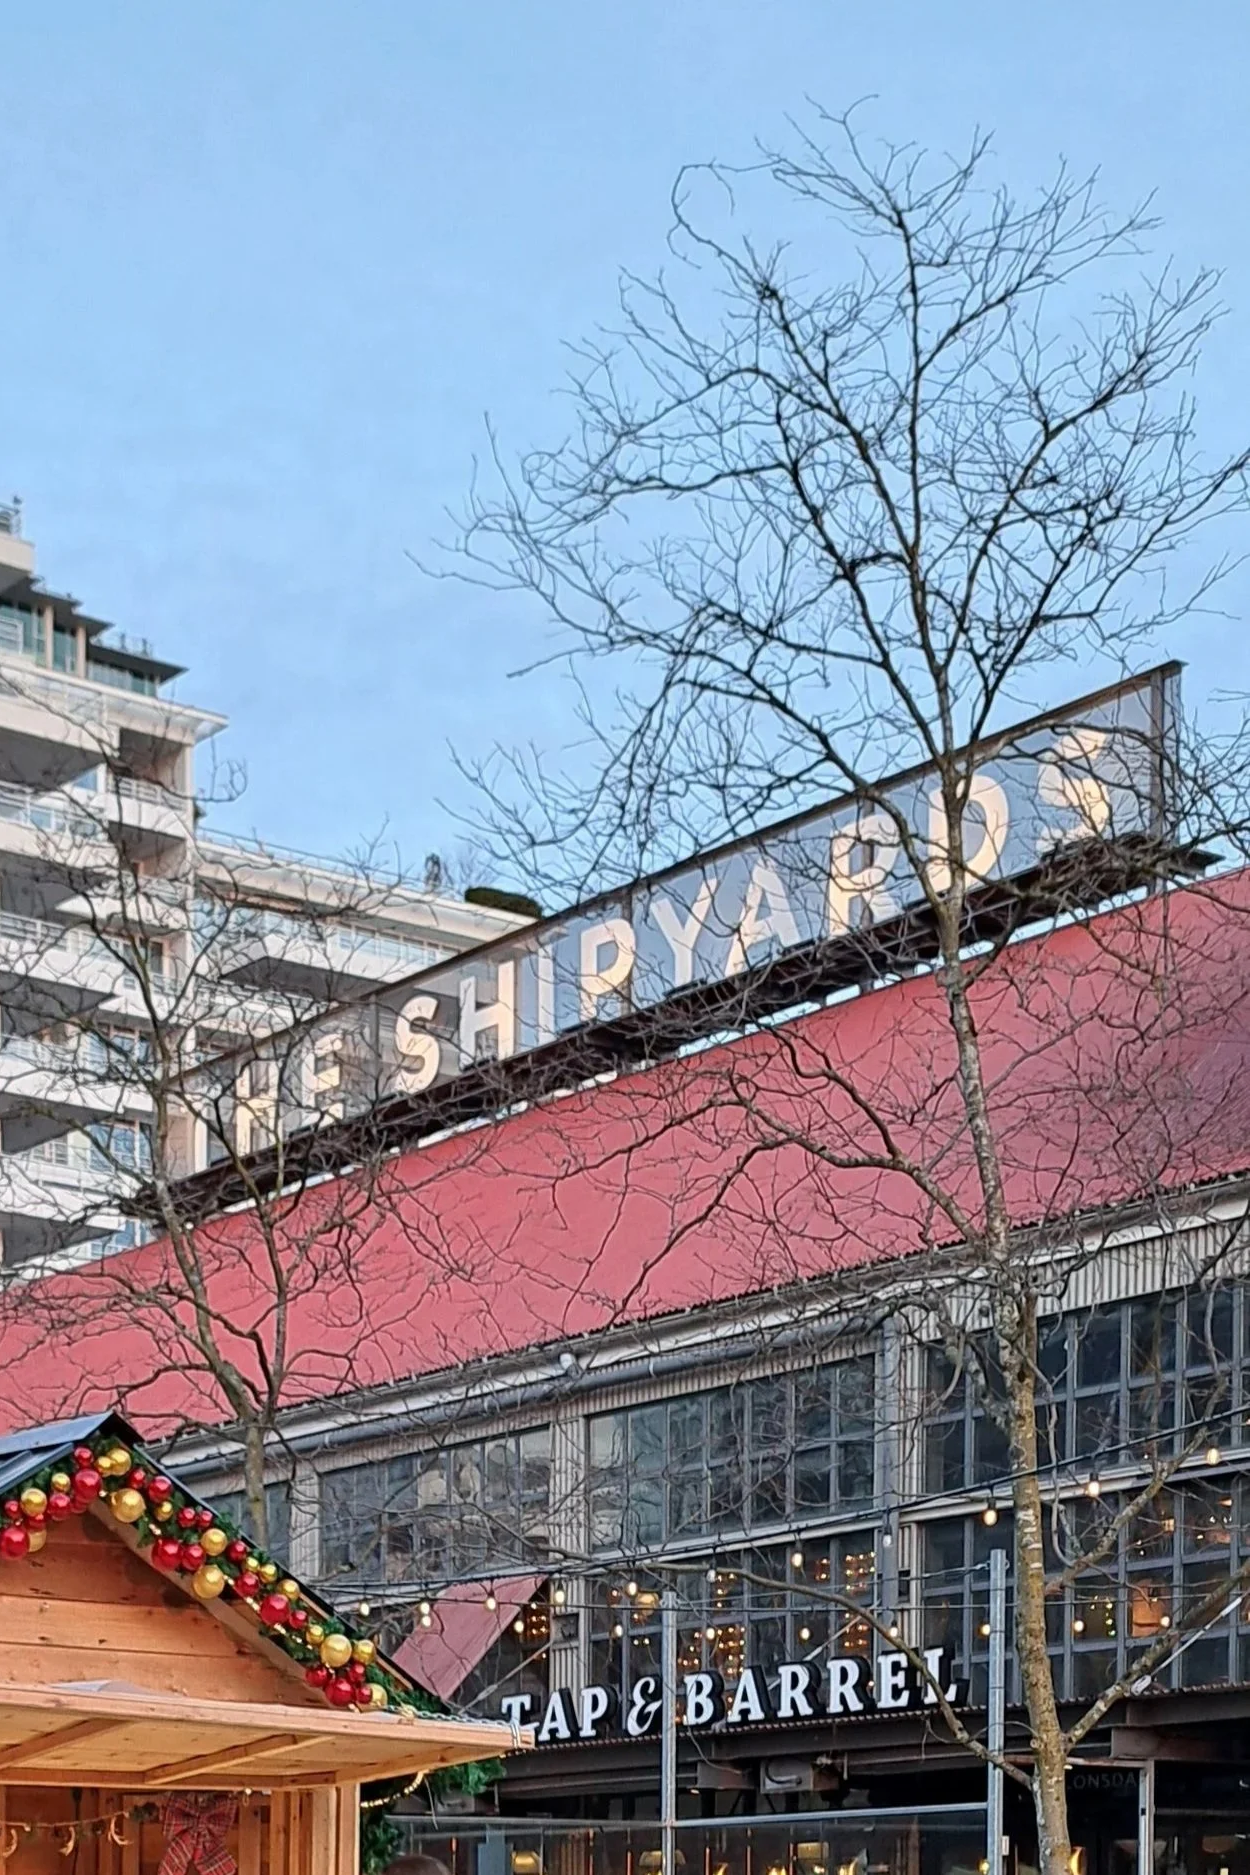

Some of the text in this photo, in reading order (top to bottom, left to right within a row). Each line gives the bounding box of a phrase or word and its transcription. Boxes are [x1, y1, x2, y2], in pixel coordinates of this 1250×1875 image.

[393, 727, 1111, 1096] SHIPYARDS
[501, 1647, 958, 1742] TAP & BARREL
